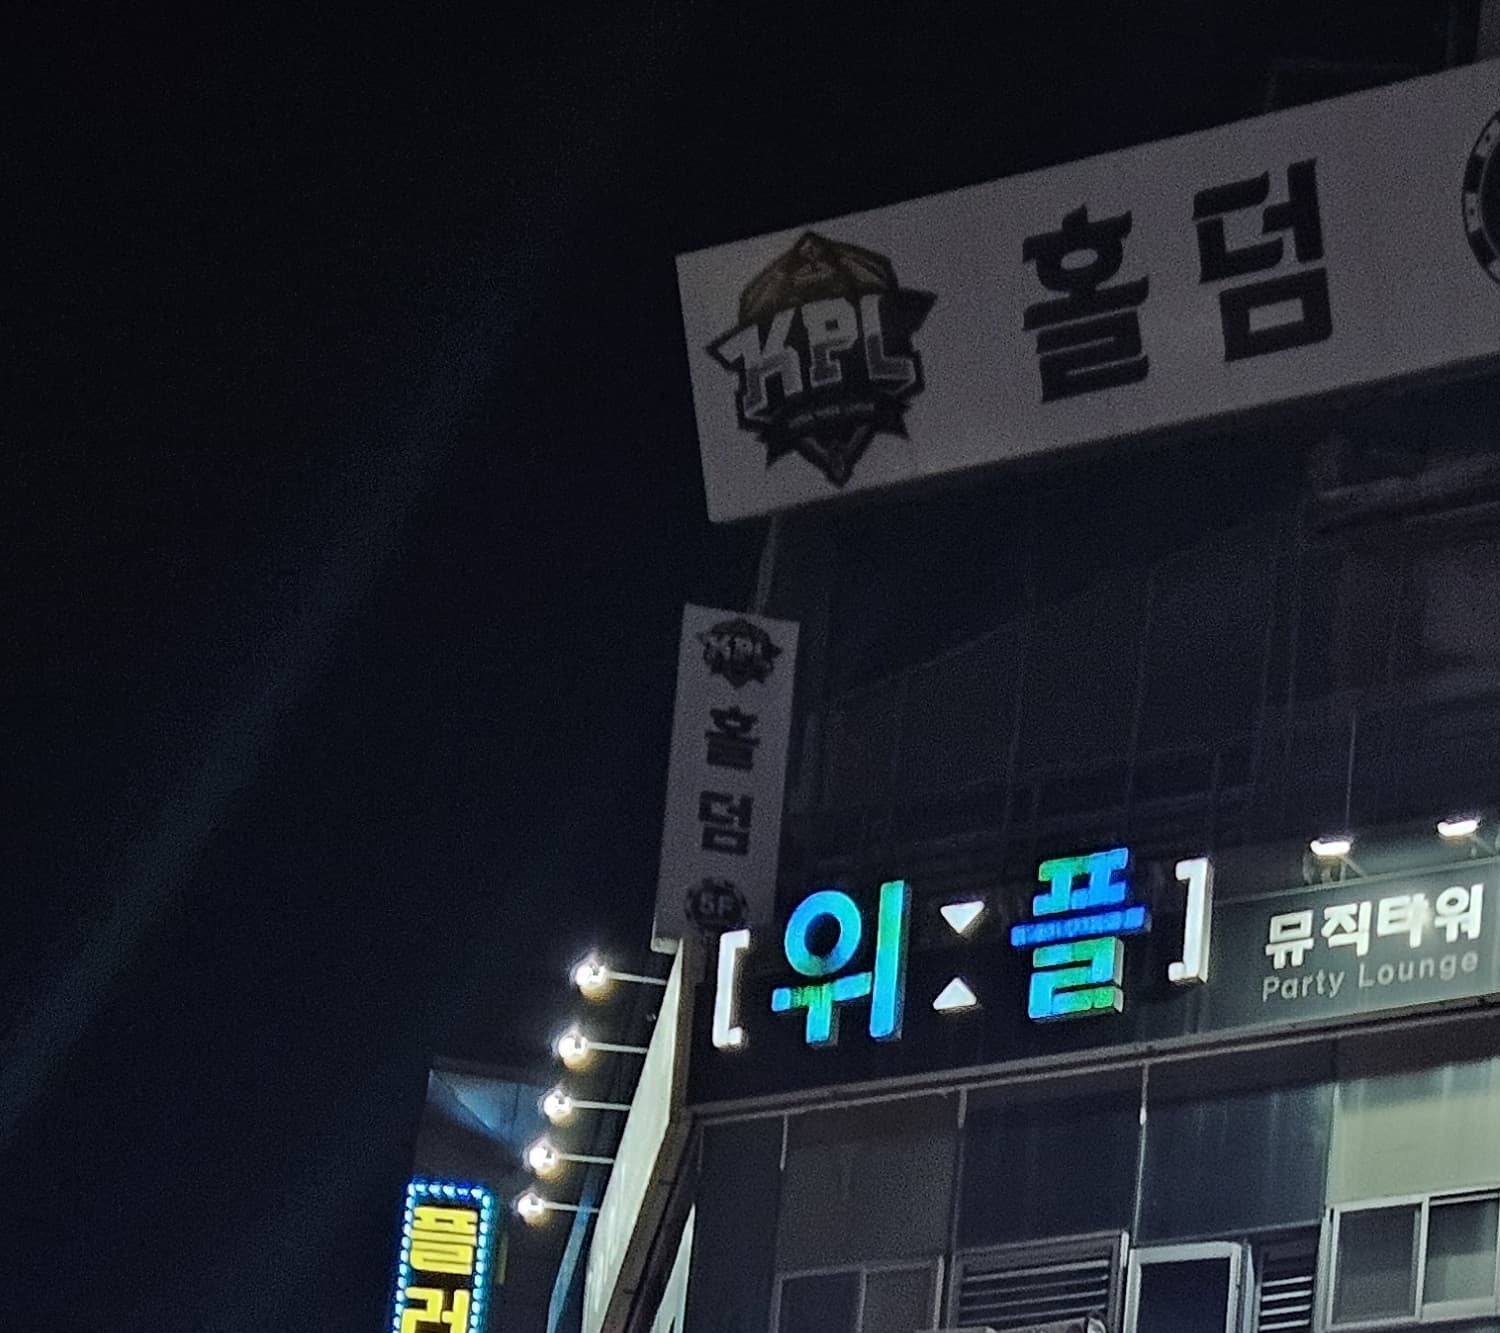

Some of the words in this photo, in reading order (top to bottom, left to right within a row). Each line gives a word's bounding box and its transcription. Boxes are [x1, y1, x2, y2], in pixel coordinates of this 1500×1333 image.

[1023, 157, 1334, 405] 홀덤
[717, 294, 917, 418] KPL
[1262, 969, 1346, 1002] Party
[1357, 951, 1479, 990] Lounge
[1264, 882, 1485, 970] 뮤직타워
